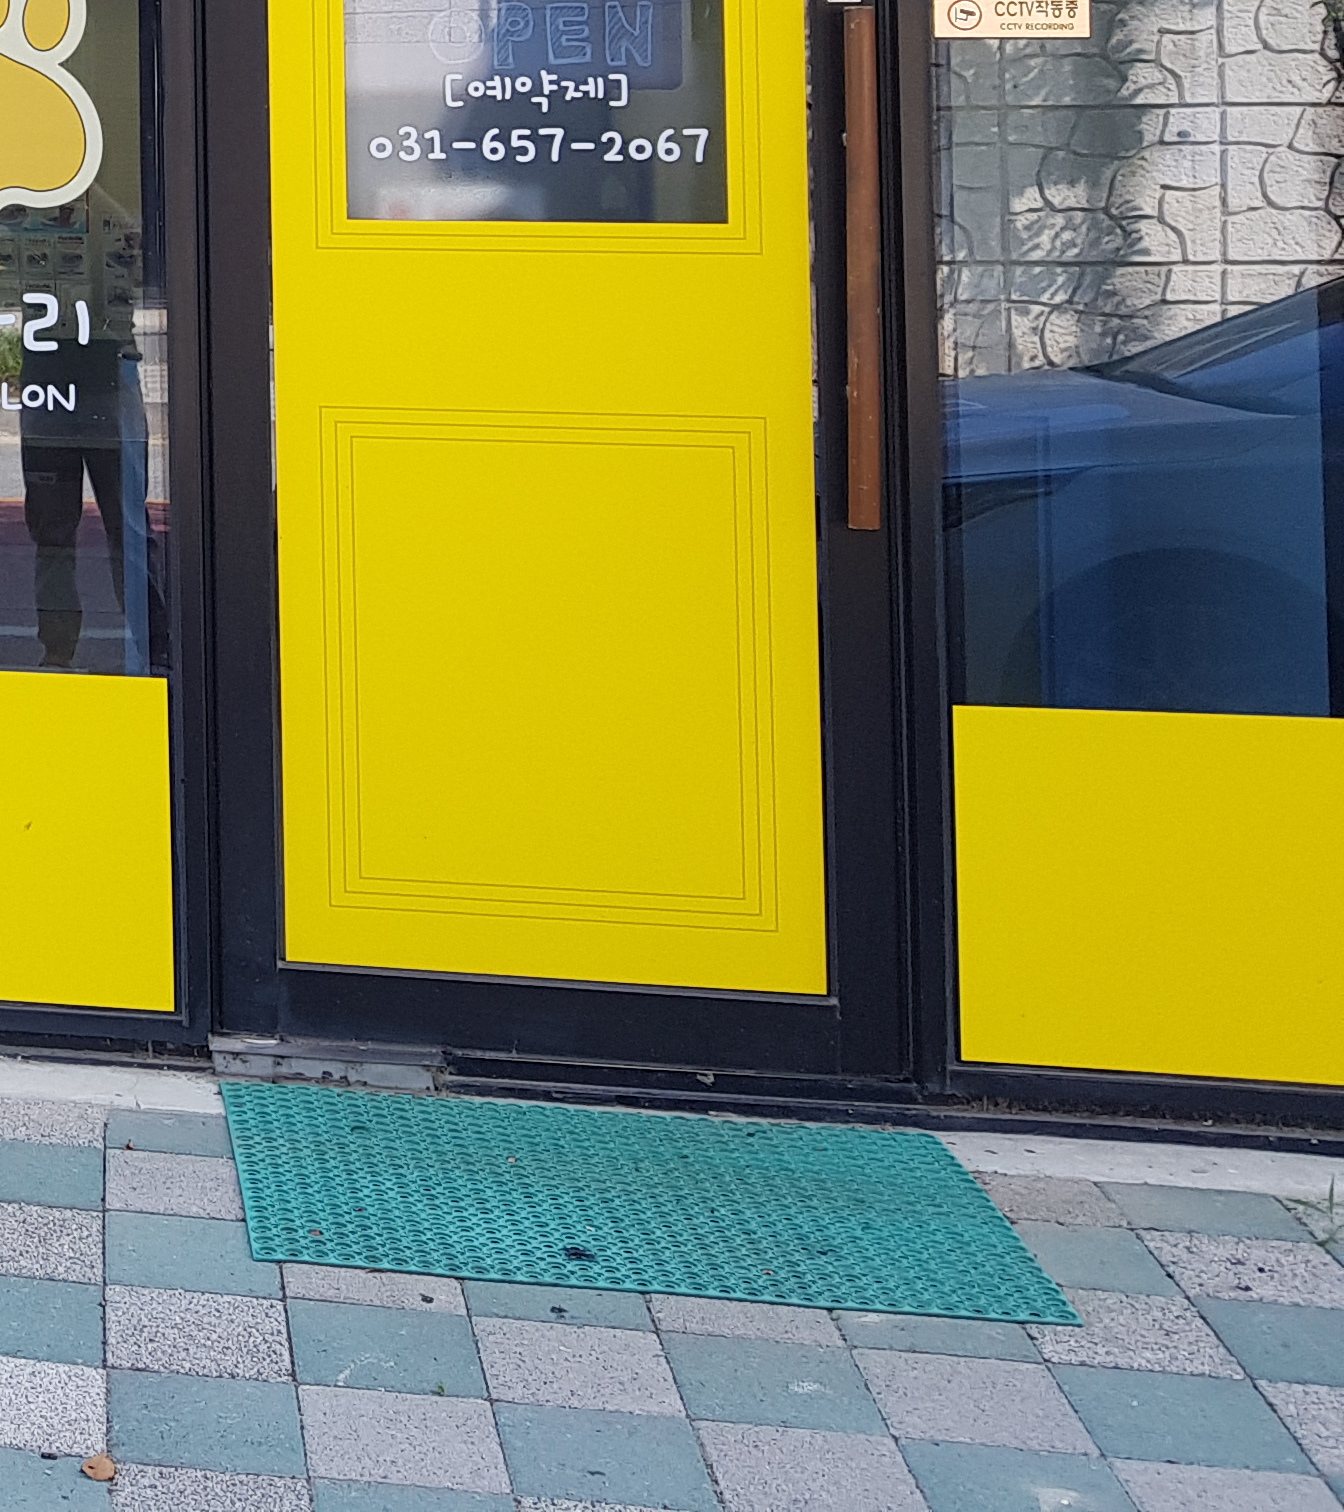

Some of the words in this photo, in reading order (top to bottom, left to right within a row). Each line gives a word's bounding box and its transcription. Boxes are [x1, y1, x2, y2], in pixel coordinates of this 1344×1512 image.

[994, 0, 1078, 19] CCTV작동중
[1000, 22, 1022, 31] CCTV
[1025, 22, 1074, 31] RECORDING
[429, 0, 653, 69] OPEN
[445, 69, 629, 113] [예약제]
[369, 125, 710, 164] 031-657-2067
